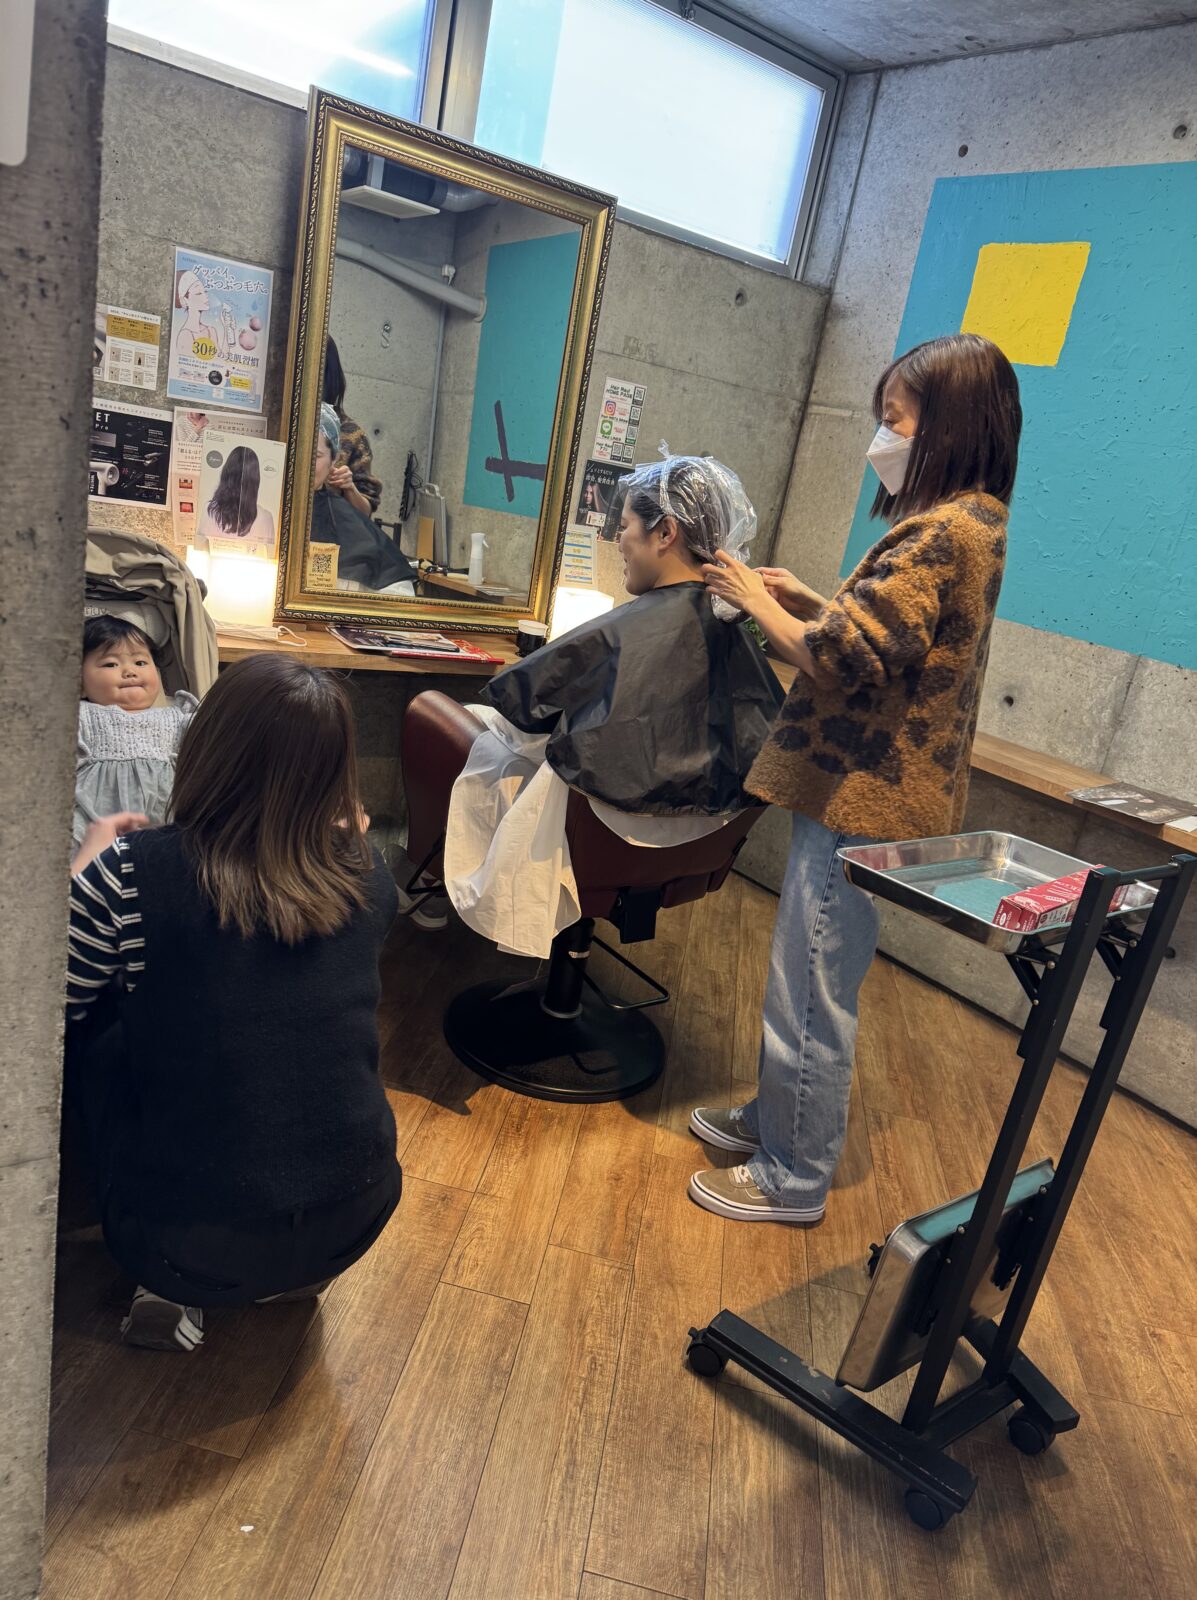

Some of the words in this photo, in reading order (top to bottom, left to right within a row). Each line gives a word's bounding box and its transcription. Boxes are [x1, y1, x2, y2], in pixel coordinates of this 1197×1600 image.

[204, 278, 269, 295] ぶつぶつ毛穴。
[192, 340, 260, 368] 30秒の美肌習慣
